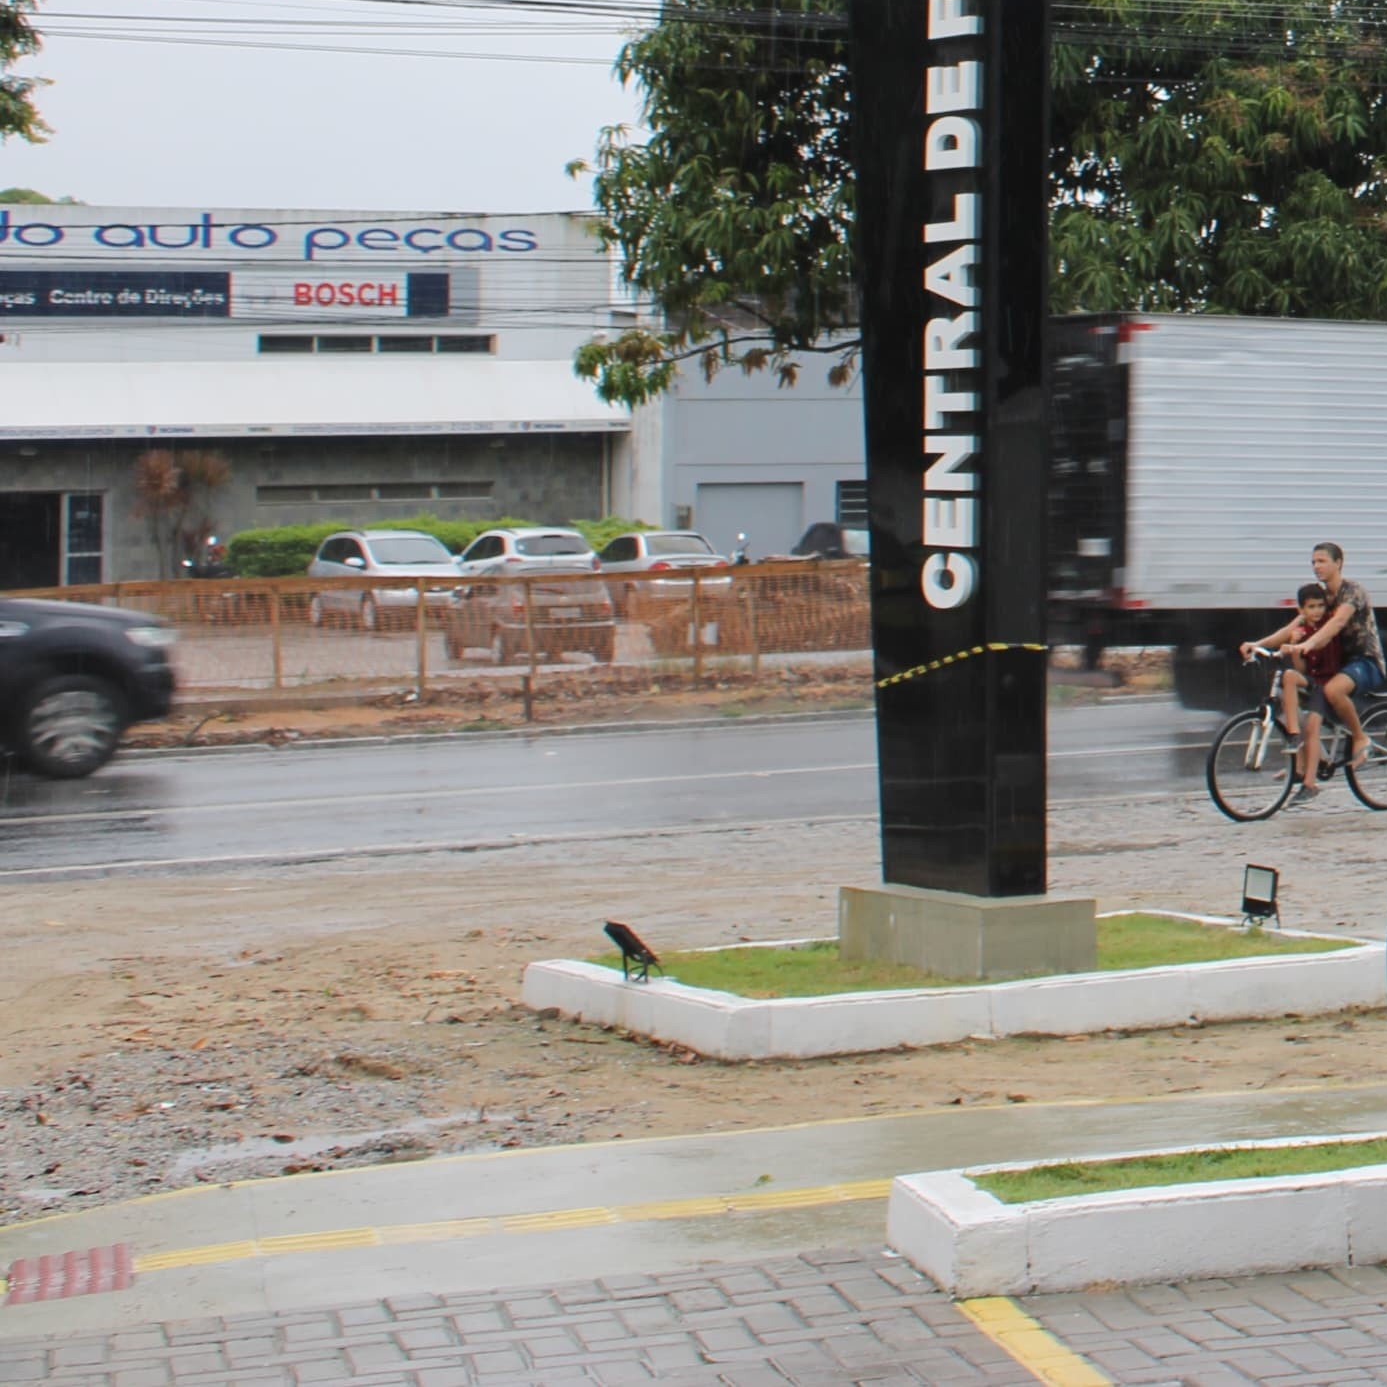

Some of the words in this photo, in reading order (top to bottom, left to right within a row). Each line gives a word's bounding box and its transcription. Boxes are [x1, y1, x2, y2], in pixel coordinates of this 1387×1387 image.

[924, 60, 983, 171] DE
[94, 213, 279, 249] auto
[304, 227, 539, 261] peças
[49, 289, 114, 305] Centro
[117, 289, 141, 305] de
[294, 282, 398, 306] BOSCH
[921, 192, 981, 610] CENTRAL
